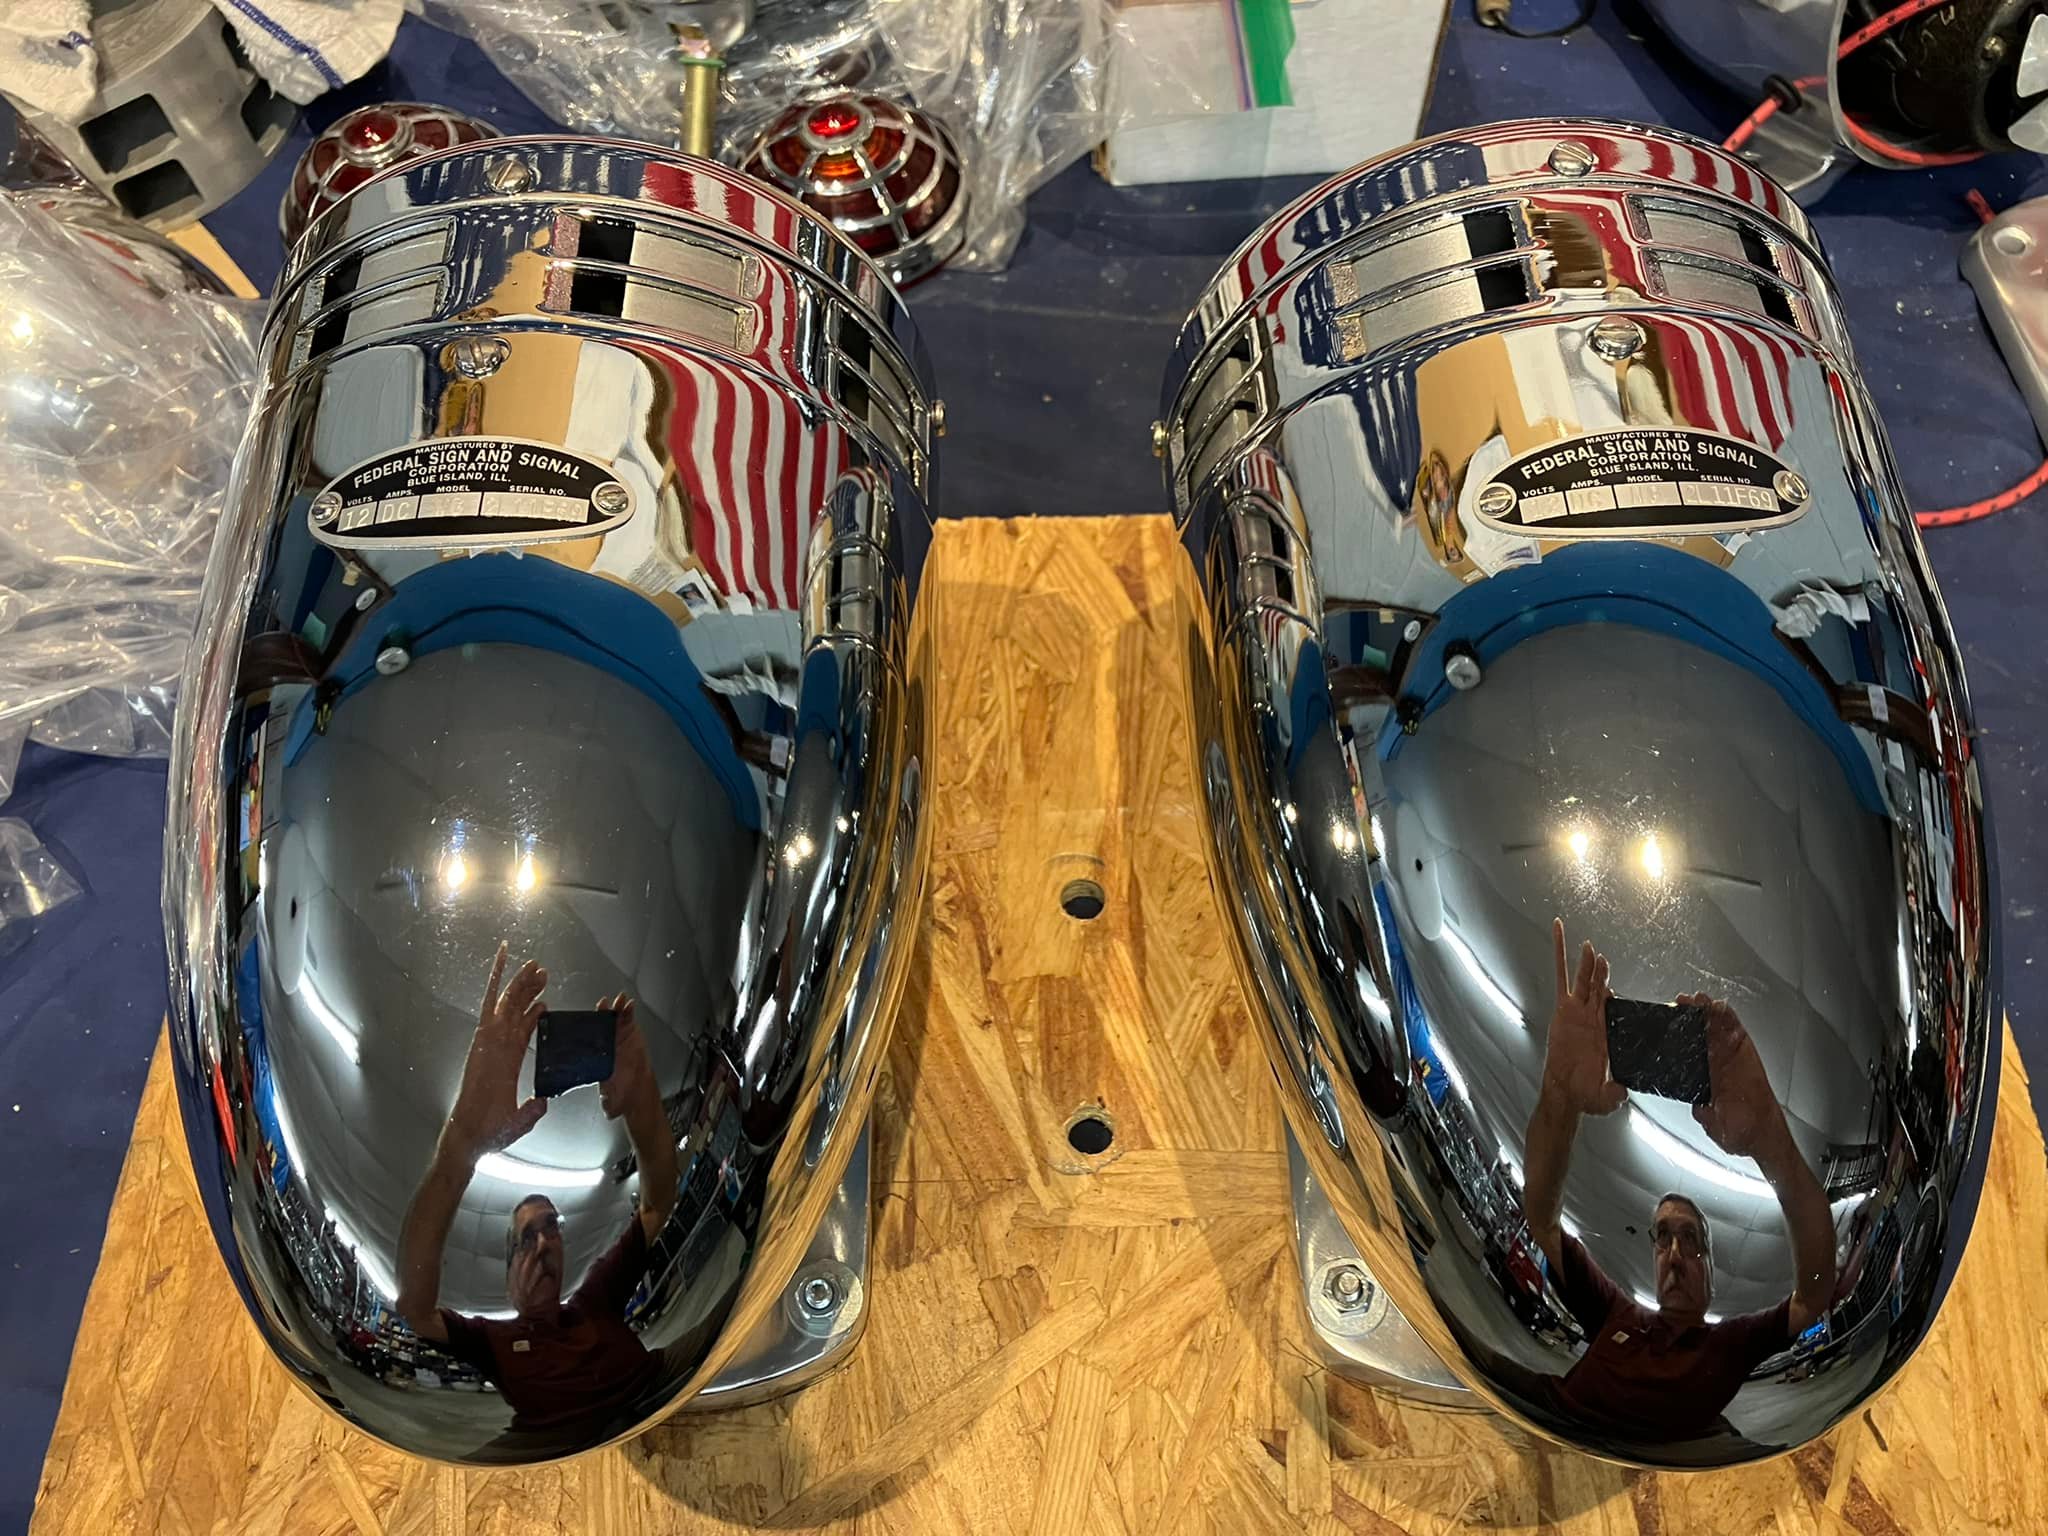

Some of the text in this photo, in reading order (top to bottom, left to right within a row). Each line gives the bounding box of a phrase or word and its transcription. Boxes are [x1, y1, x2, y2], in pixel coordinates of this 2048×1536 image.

[1585, 431, 1669, 445] MANUFACTURED
[415, 442, 515, 455] MANUFACTURED BY
[1520, 438, 1758, 480] FEDERAL SIGN AND SIGNAL
[1587, 451, 1692, 469] CORPORATION
[353, 448, 581, 489] FEDERAL SIGN AND SIGNAL
[408, 462, 510, 478] CORPORATION
[1589, 461, 1700, 478] BLUE ISLAND, ILL.
[407, 471, 512, 487] BLUE ISLAND, ILL.
[1570, 478, 1604, 489] AMPS.
[1626, 474, 1664, 483] MODEL
[1700, 474, 1735, 484] SERIAL
[385, 488, 415, 499] AMPS.
[436, 484, 471, 493] MODEL
[509, 484, 567, 497] SERIAL NO.
[1522, 485, 1556, 498] VOLTS
[346, 495, 373, 507] VOLTS
[381, 501, 410, 523] DC
[342, 507, 370, 532] 12
